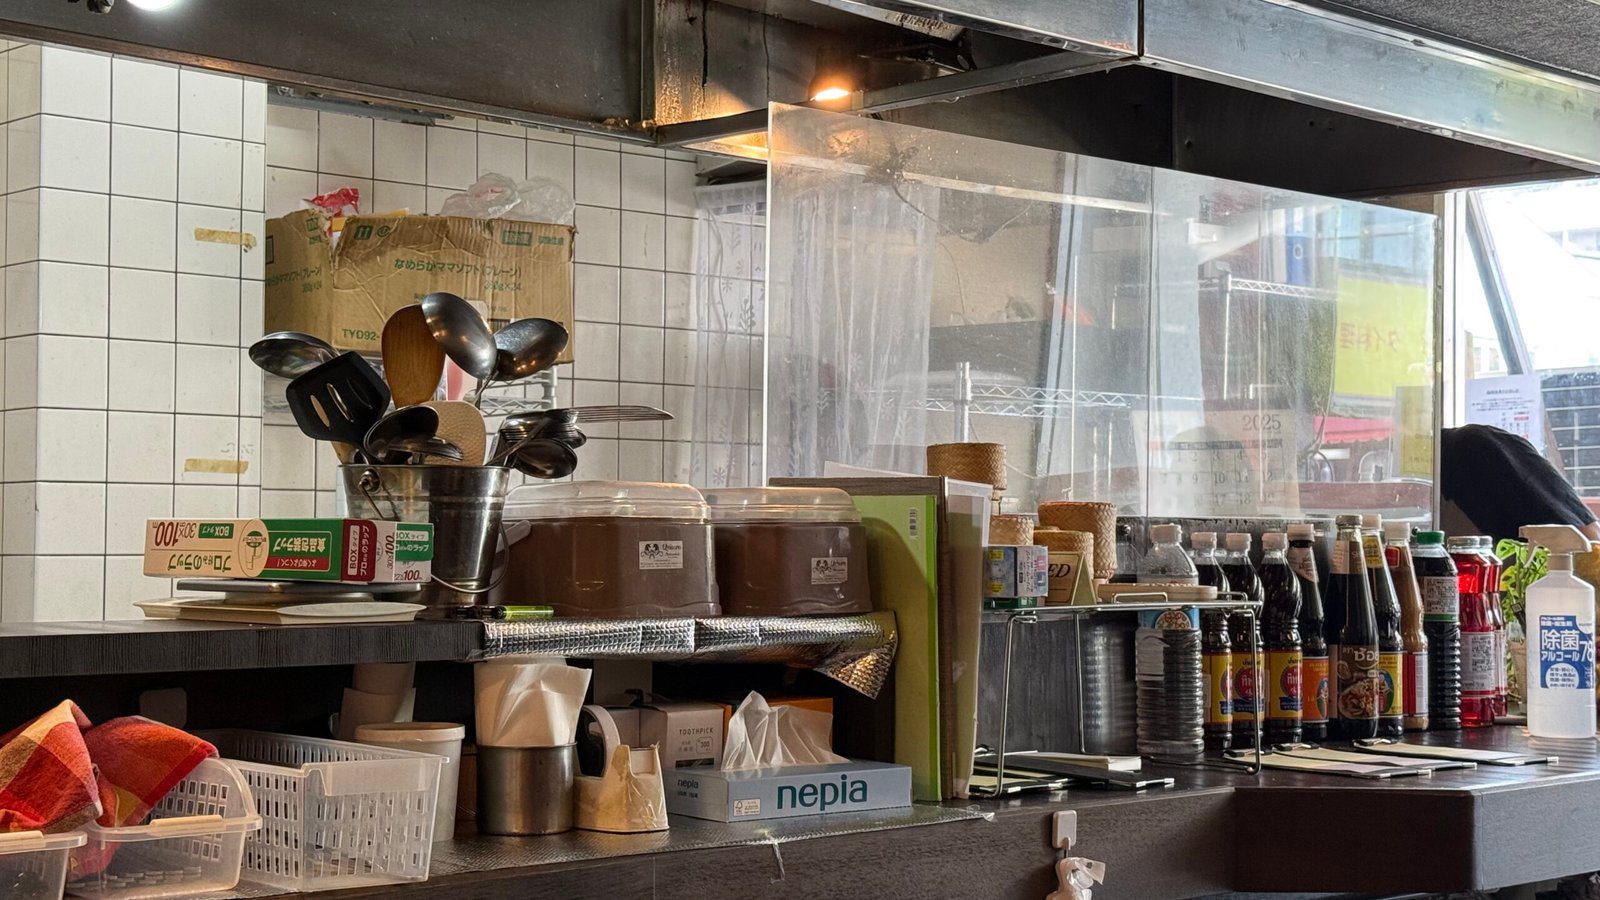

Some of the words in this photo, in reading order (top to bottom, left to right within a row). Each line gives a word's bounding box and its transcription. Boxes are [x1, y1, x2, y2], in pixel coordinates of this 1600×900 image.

[1242, 413, 1282, 431] 2025
[272, 537, 327, 553] 食品包装ラップ
[167, 553, 232, 573] プロ好みのラップ
[1541, 629, 1580, 651] 除菌
[1541, 651, 1580, 662] アルコール
[679, 727, 714, 735] TOOTHPICK
[677, 779, 699, 789] nepia
[777, 773, 868, 811] nepia
